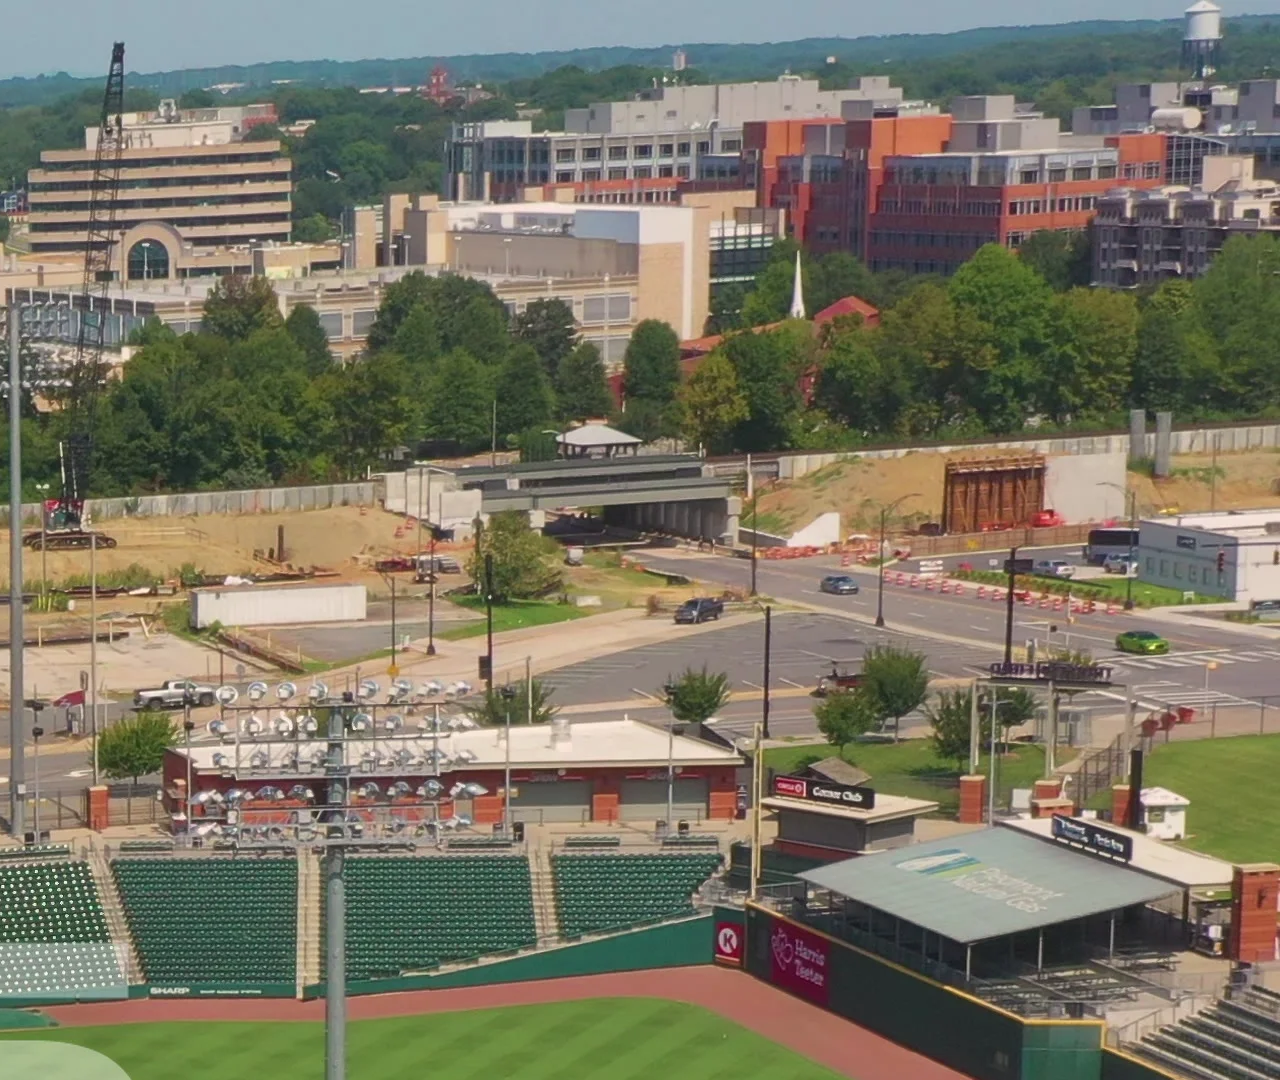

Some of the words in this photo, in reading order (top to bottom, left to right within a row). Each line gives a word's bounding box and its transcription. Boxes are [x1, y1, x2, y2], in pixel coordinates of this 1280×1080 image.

[812, 786, 842, 800] Corner
[842, 791, 862, 802] Club
[794, 938, 825, 967] Harris
[794, 959, 825, 987] Teeter
[150, 986, 190, 995] SHARP
